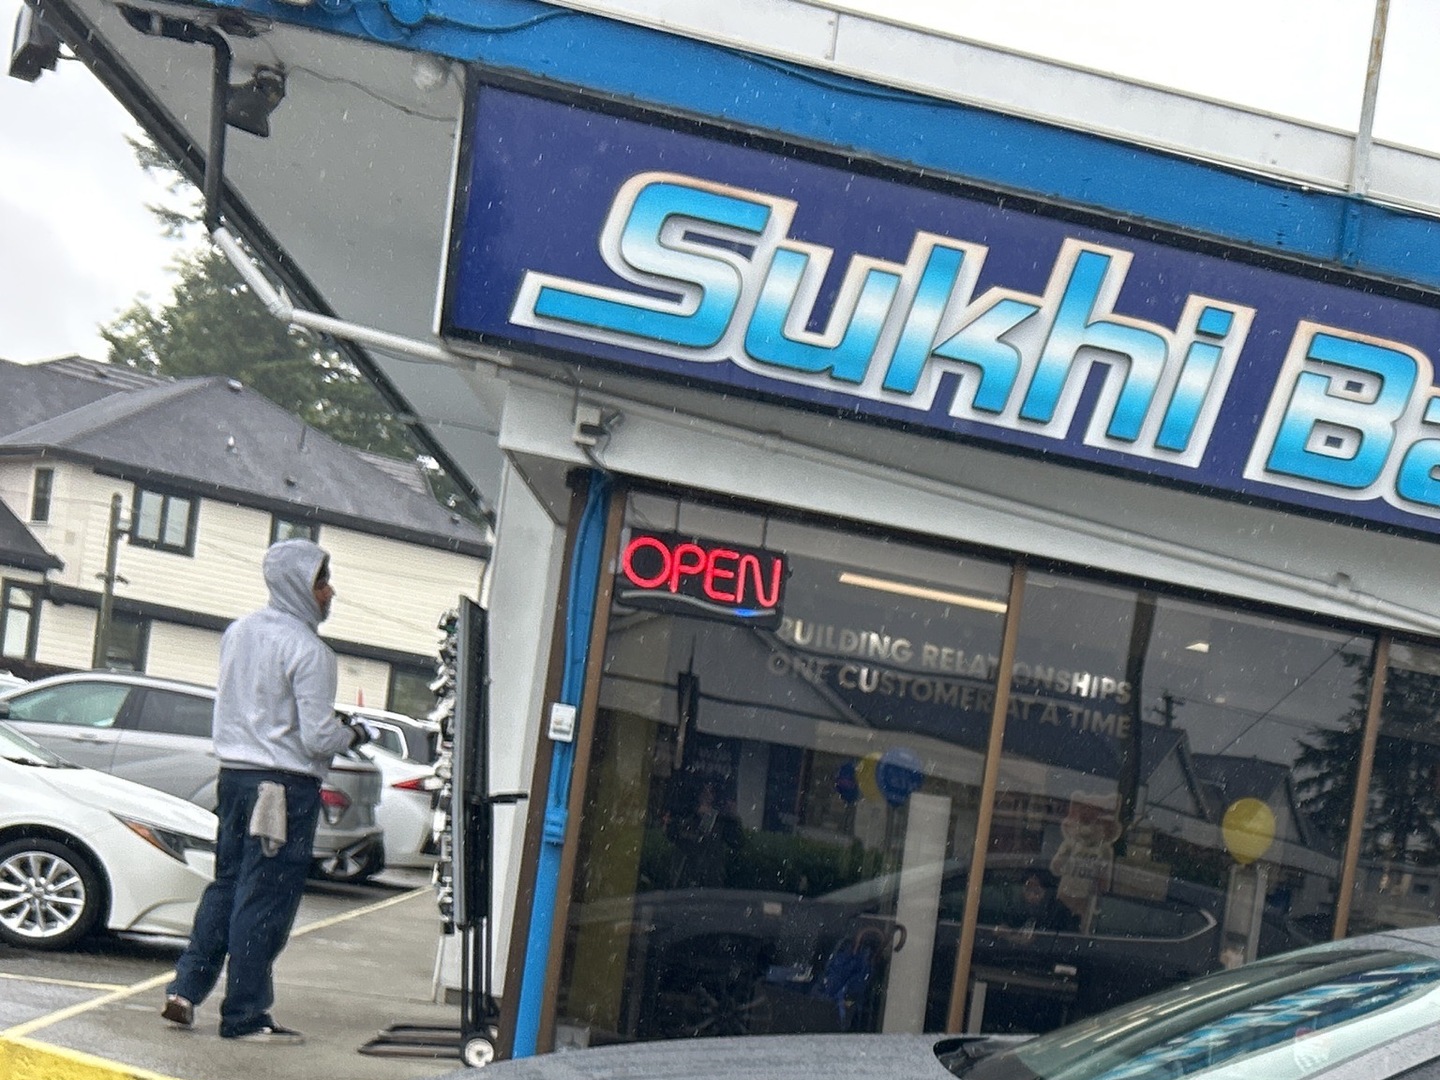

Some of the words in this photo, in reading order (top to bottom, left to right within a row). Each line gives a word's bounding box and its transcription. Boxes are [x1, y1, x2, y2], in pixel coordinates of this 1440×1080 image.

[509, 171, 1256, 468] Sukhi
[622, 536, 782, 608] OPEN
[768, 652, 830, 684] ONE
[838, 664, 994, 714] CUSTOMER
[1039, 701, 1060, 727] A
[1067, 704, 1131, 739] TIME
[776, 616, 913, 664] BUILDING
[922, 643, 1132, 705] RELATONSHIPS
